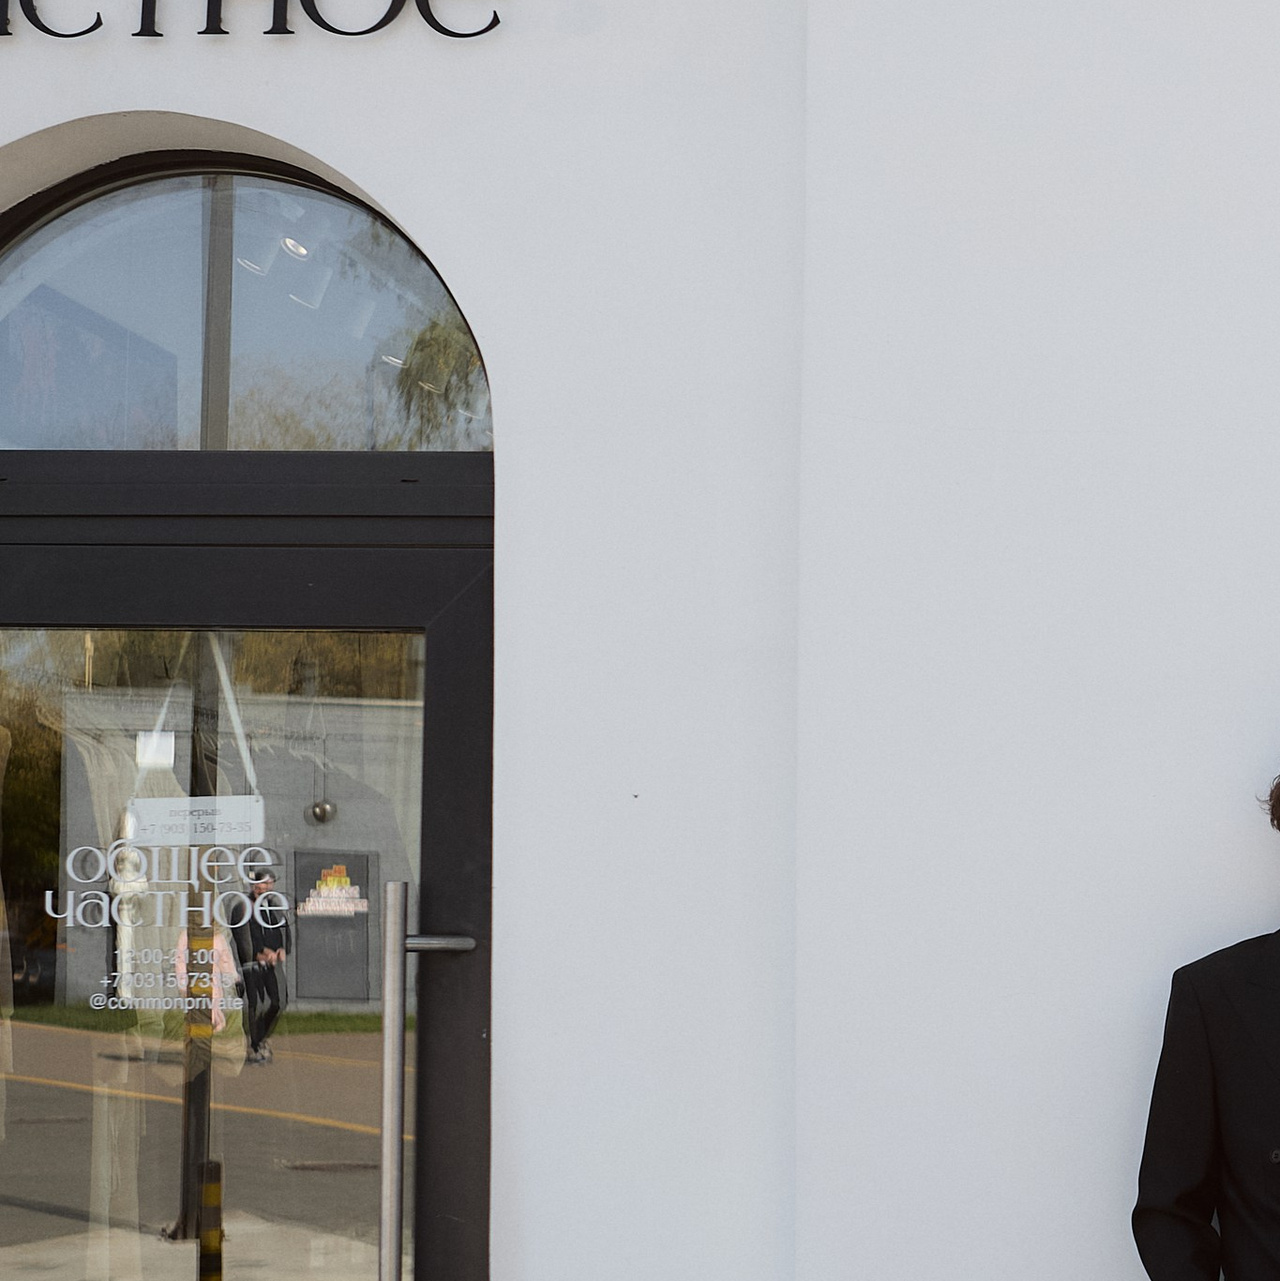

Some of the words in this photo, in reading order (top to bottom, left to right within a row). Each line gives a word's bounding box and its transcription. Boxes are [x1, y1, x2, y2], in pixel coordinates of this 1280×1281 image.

[66, 838, 273, 893] общее
[44, 890, 290, 928] частное
[89, 993, 244, 1012] @commonprivate
